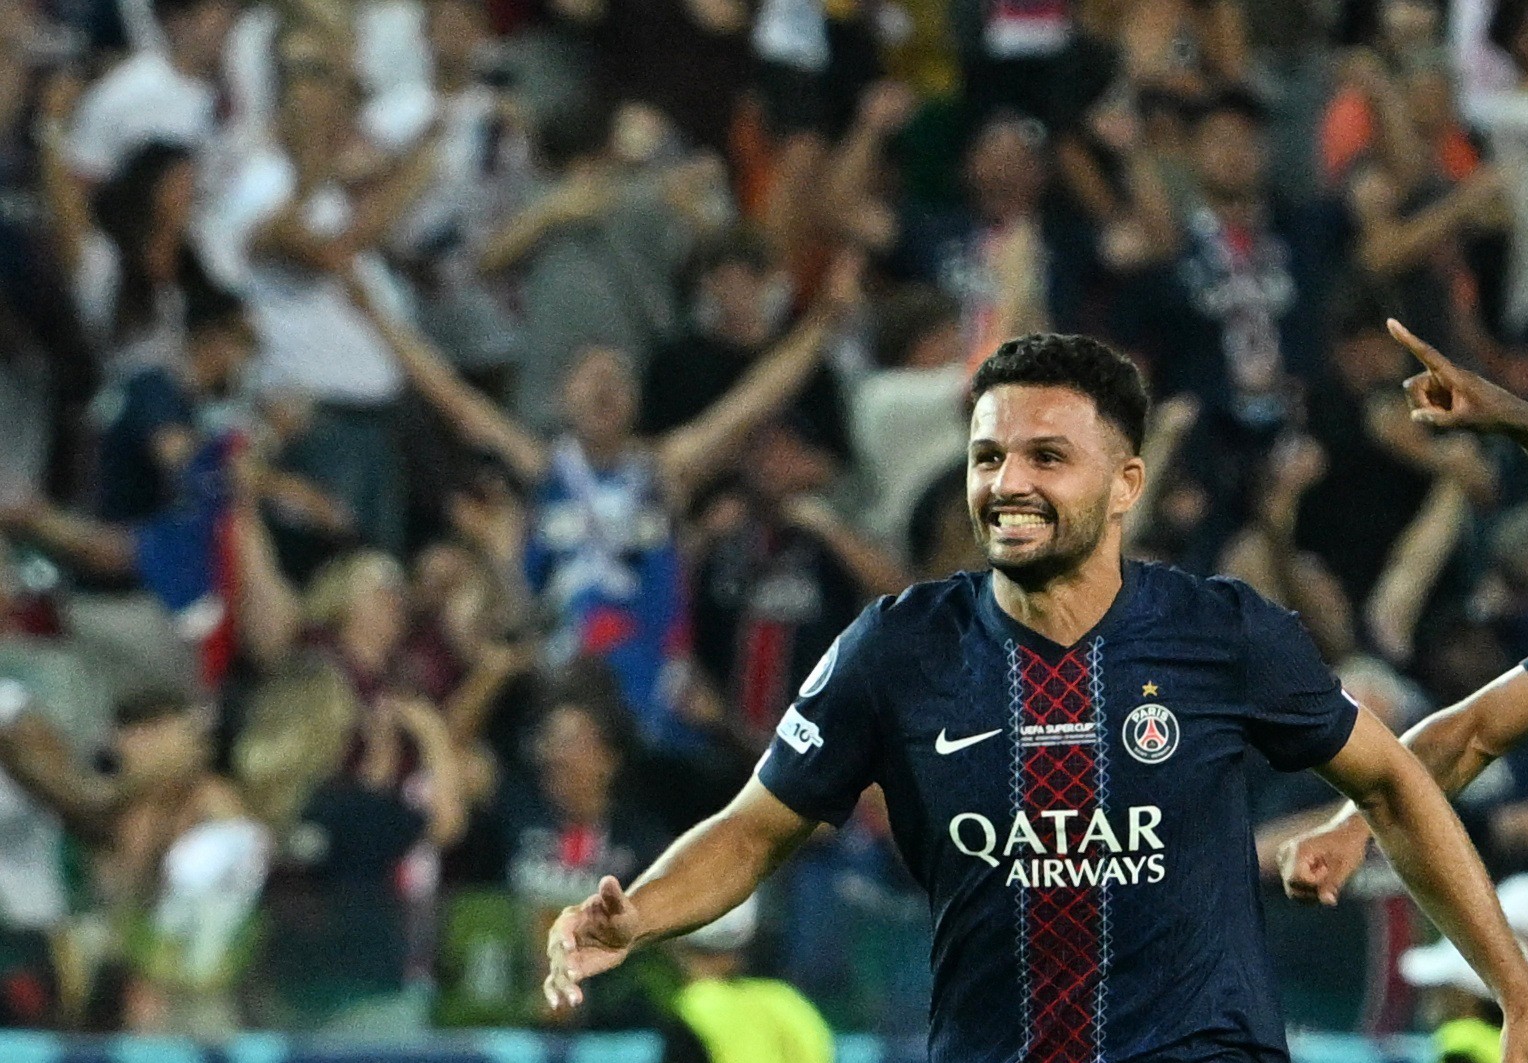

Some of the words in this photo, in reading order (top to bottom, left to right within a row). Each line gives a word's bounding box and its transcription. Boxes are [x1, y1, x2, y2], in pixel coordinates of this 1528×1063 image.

[1131, 707, 1169, 723] PARIS
[1020, 724, 1045, 736] UEFA
[949, 805, 1165, 868] QATAR
[1005, 854, 1165, 888] AIRWAYS
